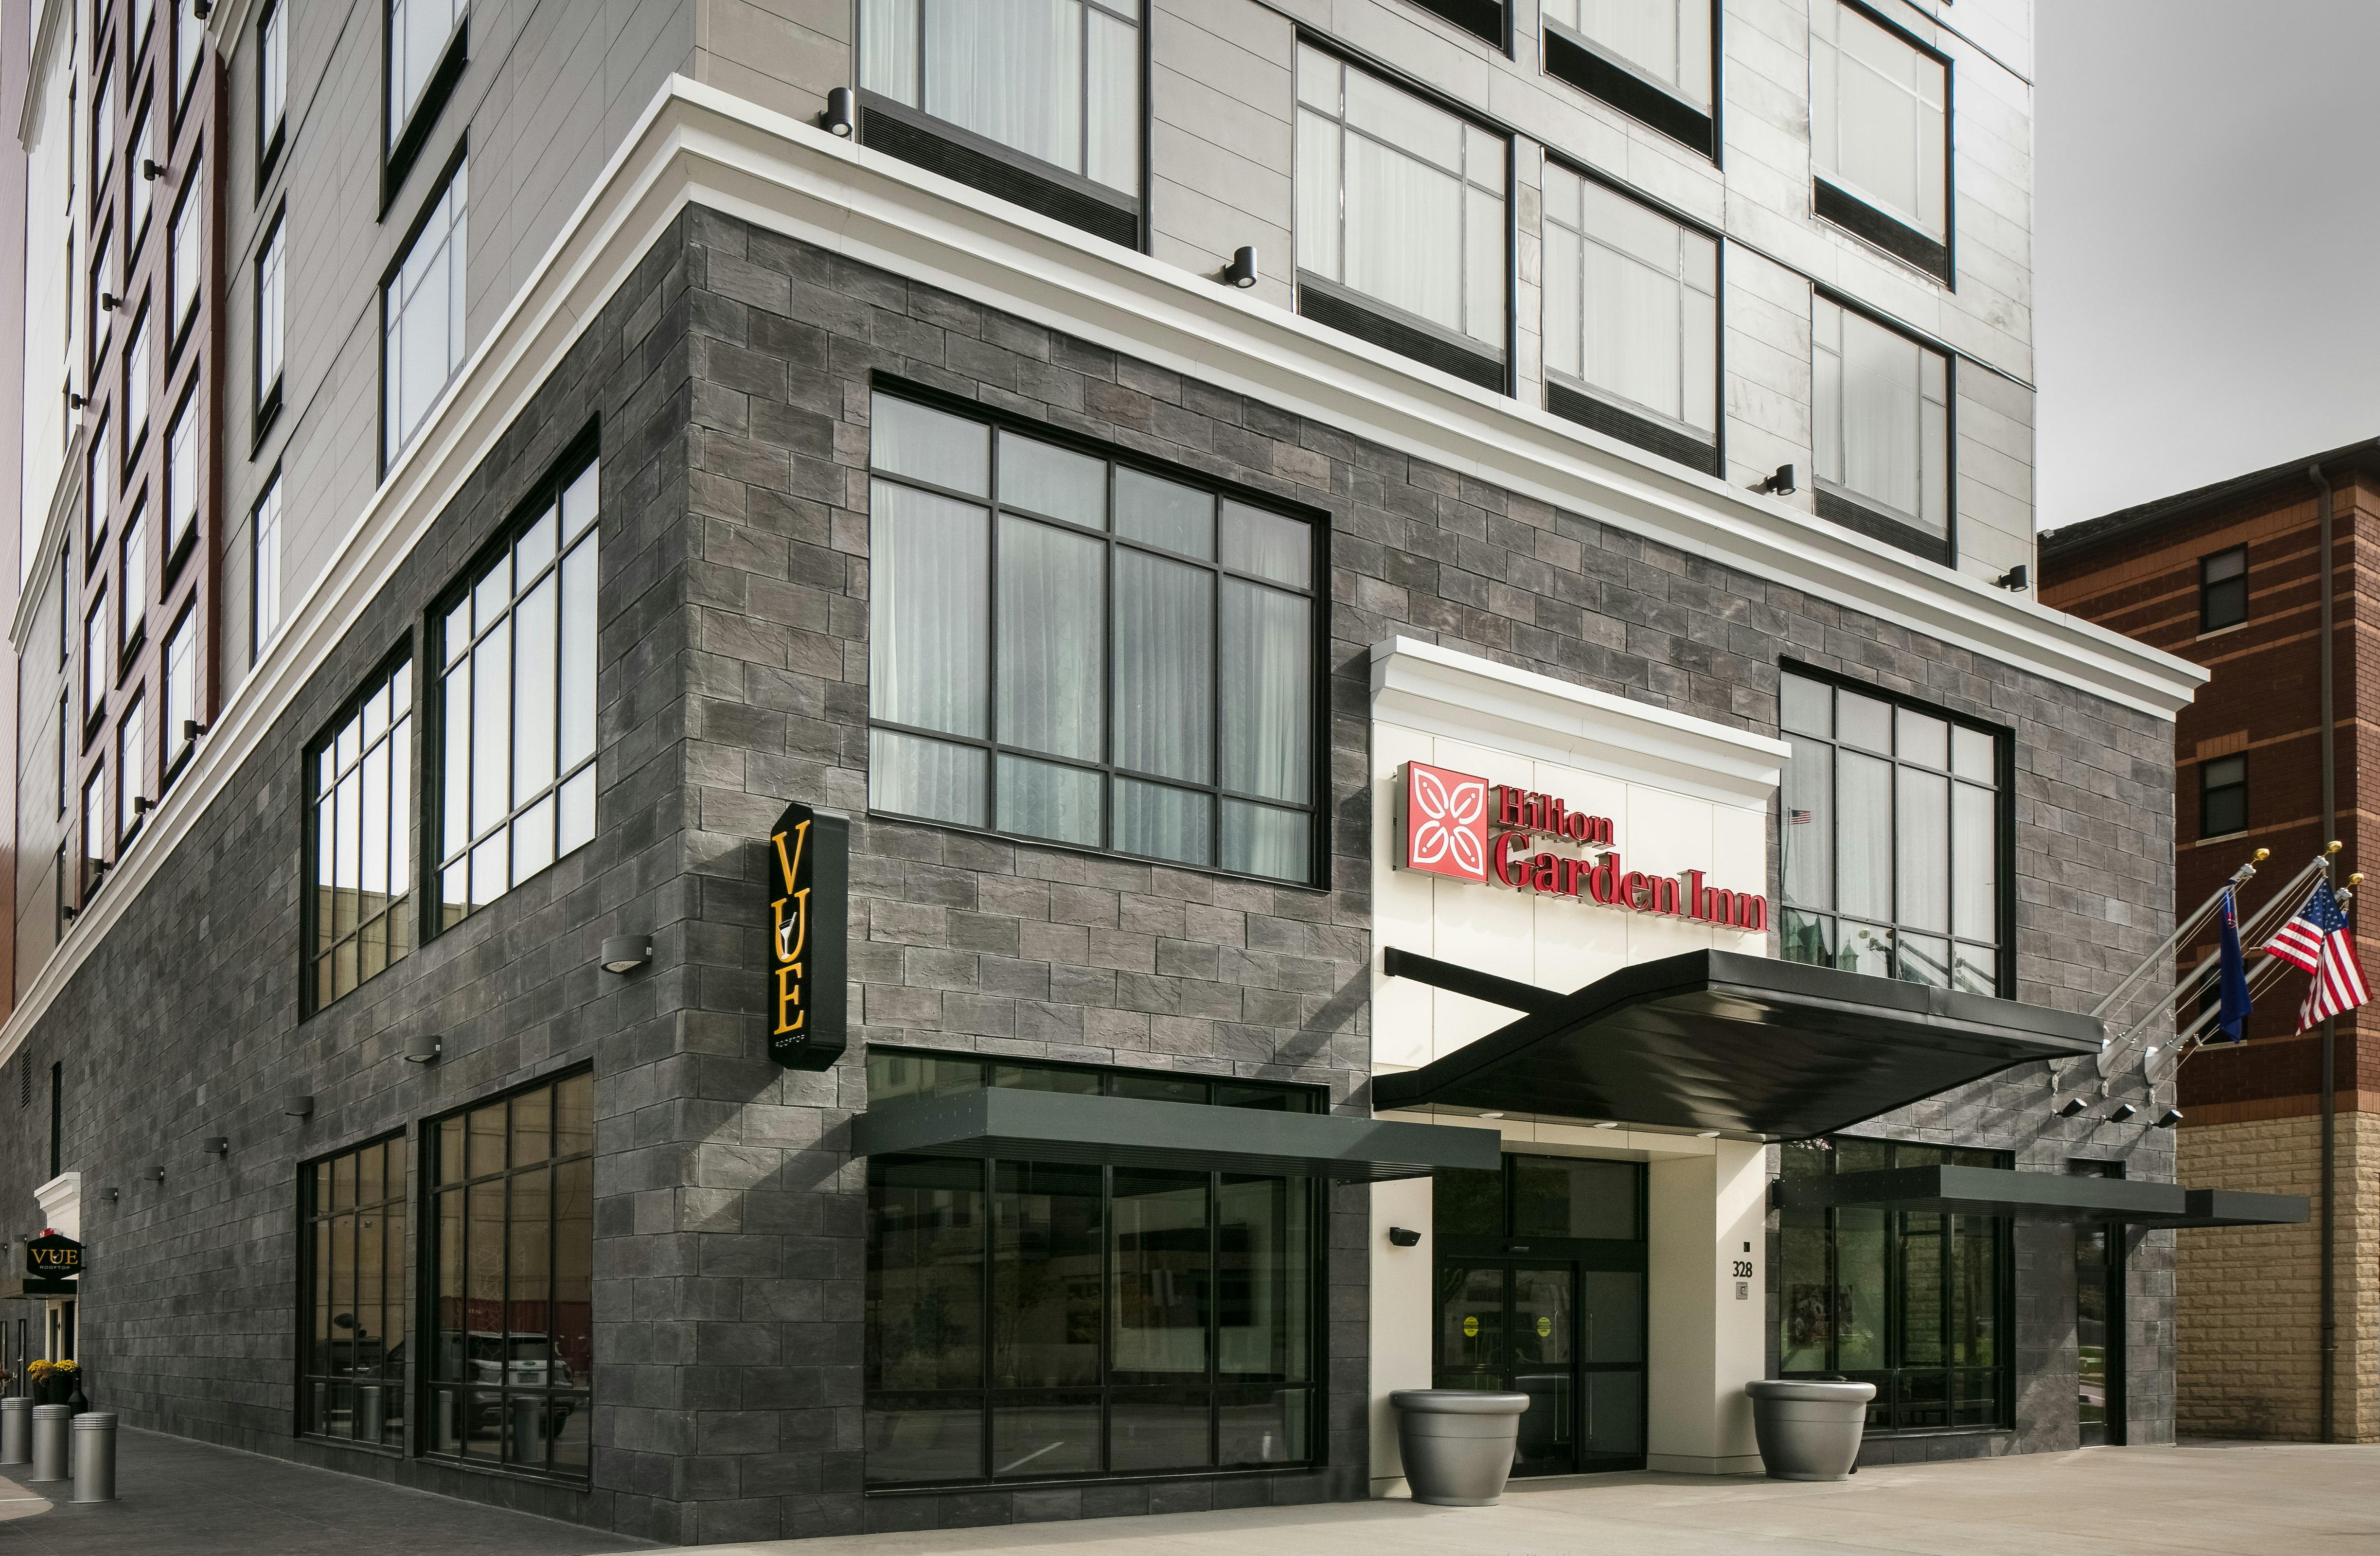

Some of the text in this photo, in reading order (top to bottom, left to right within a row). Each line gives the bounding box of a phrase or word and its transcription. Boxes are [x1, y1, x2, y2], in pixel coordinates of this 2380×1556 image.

[1497, 784, 1616, 846] Hilton
[1494, 831, 1770, 932] Garden Inn
[771, 819, 811, 1035] VUE
[775, 1034, 805, 1048] ROOFTOP
[31, 1249, 78, 1264] VUE
[1733, 1261, 1753, 1278] 328
